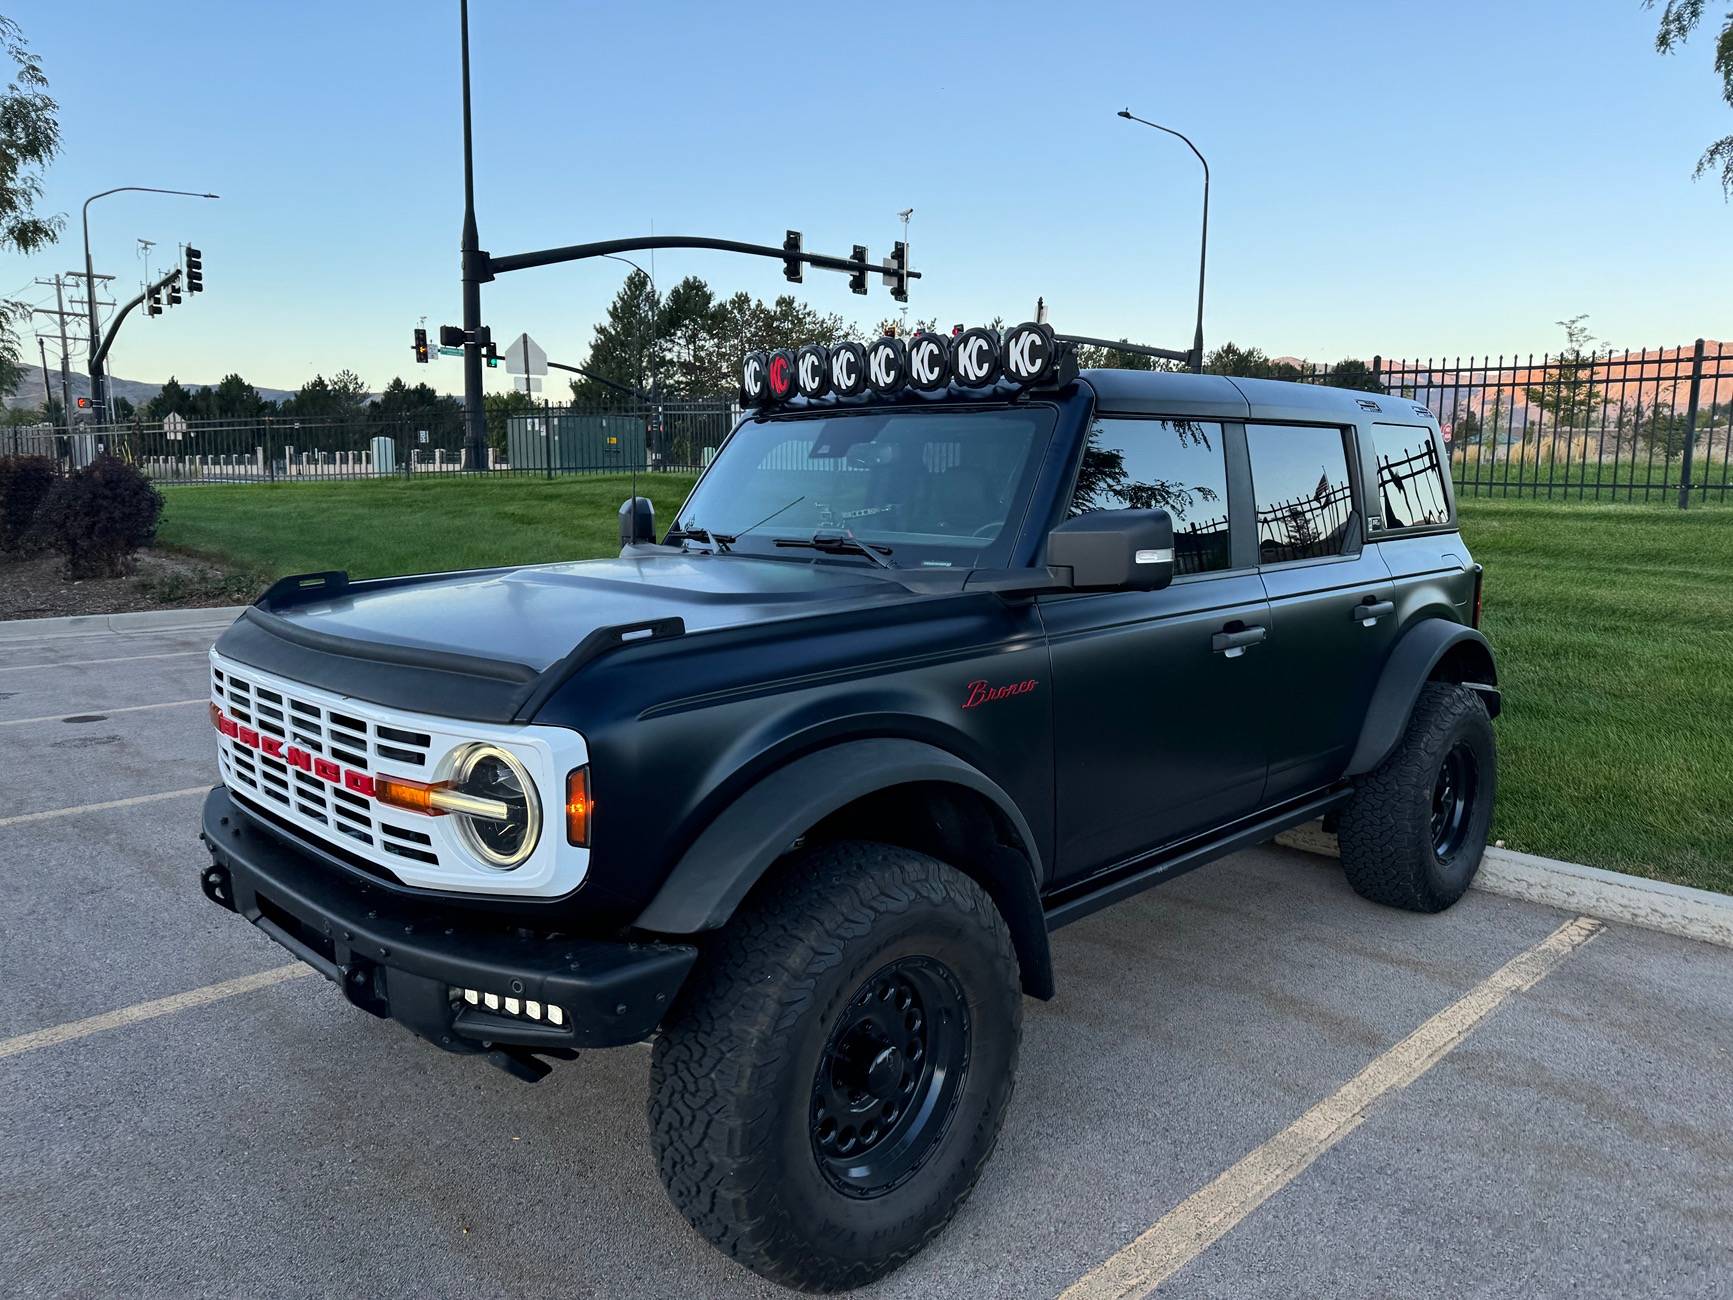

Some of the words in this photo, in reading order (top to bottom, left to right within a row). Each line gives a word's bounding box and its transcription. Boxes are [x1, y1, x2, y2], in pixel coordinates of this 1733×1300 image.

[799, 352, 819, 392] KC
[832, 349, 855, 390] KC
[870, 345, 895, 387] KC
[911, 340, 940, 383] KC
[958, 335, 989, 381] KC
[1009, 330, 1043, 377] KC
[744, 358, 761, 395] KC
[769, 355, 789, 394] KC
[961, 679, 1039, 709] Bronco
[219, 715, 377, 797] BRONCO
